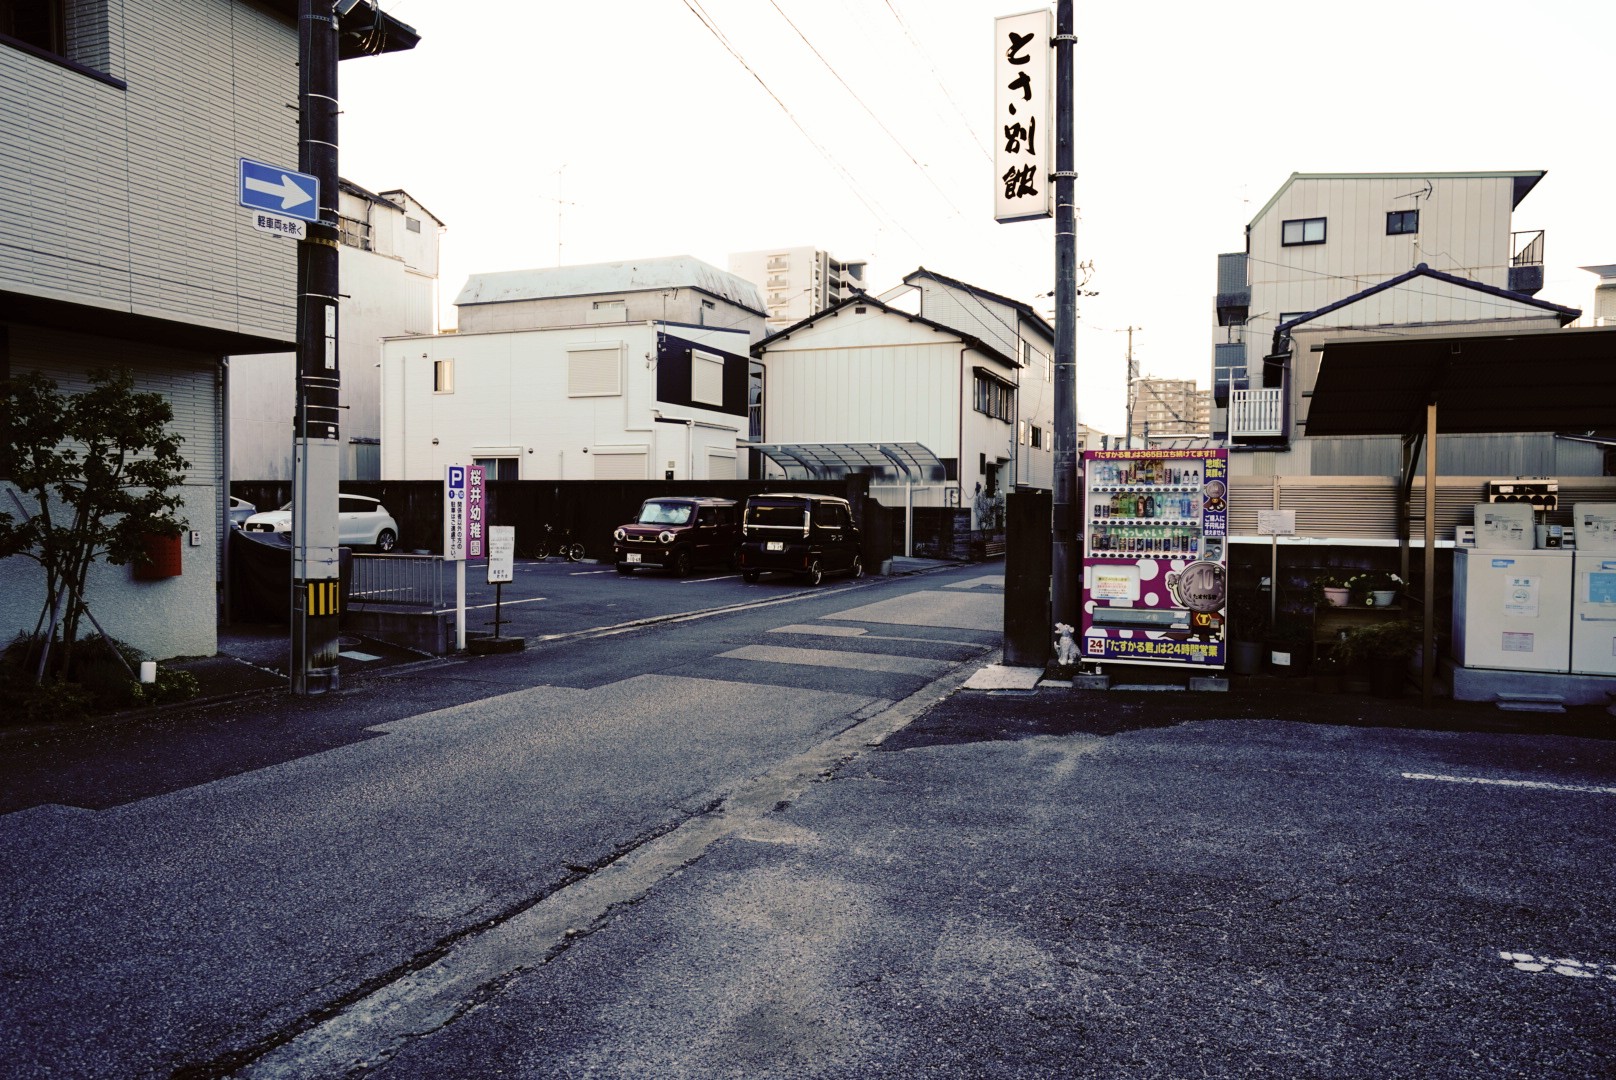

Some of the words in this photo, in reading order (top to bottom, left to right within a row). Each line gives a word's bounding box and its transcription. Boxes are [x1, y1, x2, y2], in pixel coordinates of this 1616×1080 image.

[257, 214, 302, 235] 軽車両を除く
[1205, 458, 1226, 468] 地域に
[451, 469, 462, 486] P
[470, 469, 481, 556] 桜井幼稚園
[1205, 514, 1225, 522] ご購入に
[1205, 522, 1225, 530] 千円札は
[1111, 527, 1184, 538] いらっしゃいませ
[1197, 568, 1214, 590] 10
[1200, 614, 1208, 624] T
[1090, 640, 1103, 648] 24
[1106, 640, 1218, 657] 「たすかる君」は24時間営業
